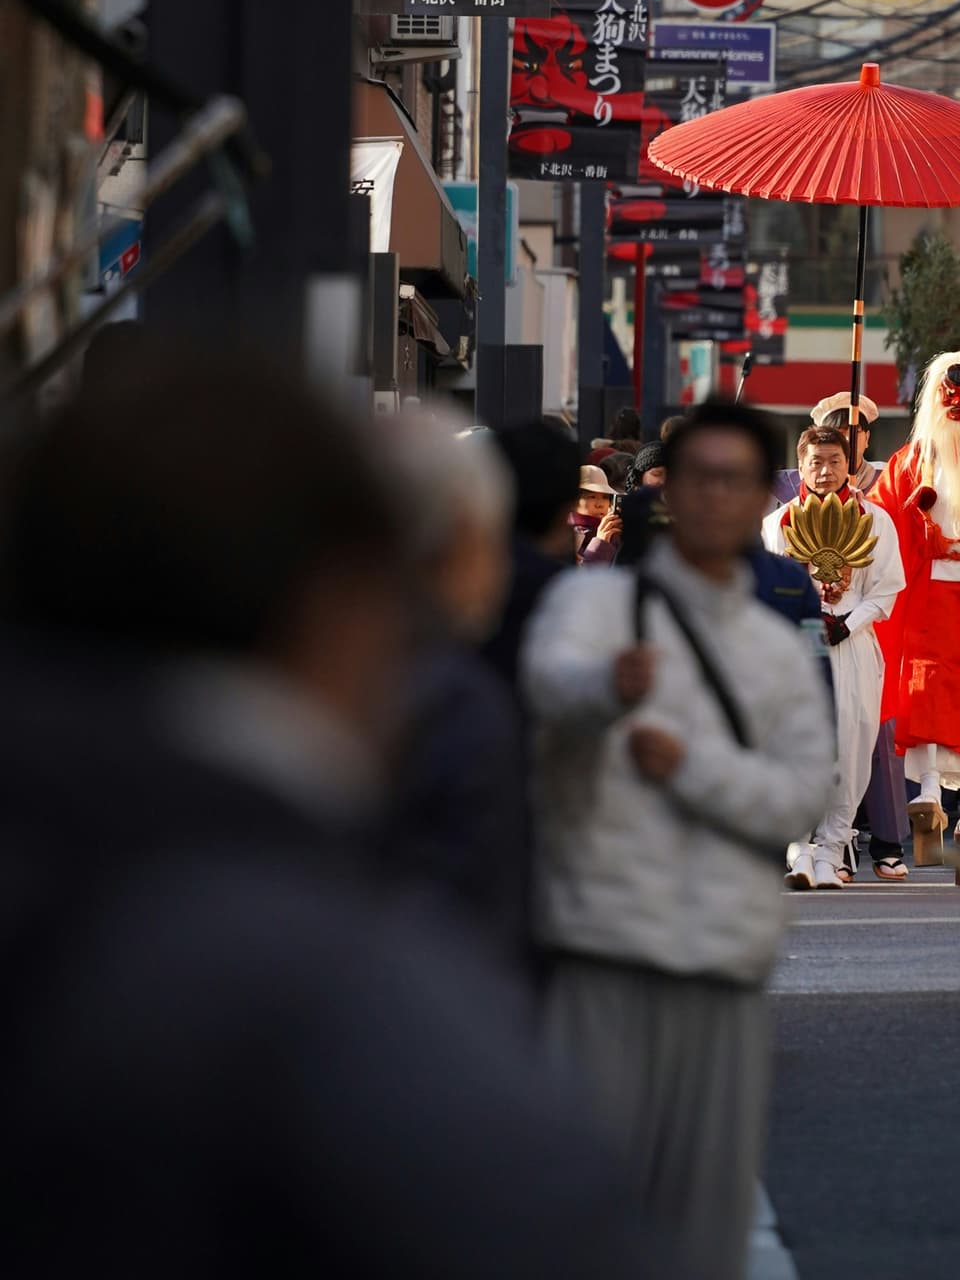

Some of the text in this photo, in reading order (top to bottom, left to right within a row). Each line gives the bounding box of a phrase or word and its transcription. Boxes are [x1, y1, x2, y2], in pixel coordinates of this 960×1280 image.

[722, 47, 765, 64] Homes
[540, 164, 608, 179] 下北沢一番街
